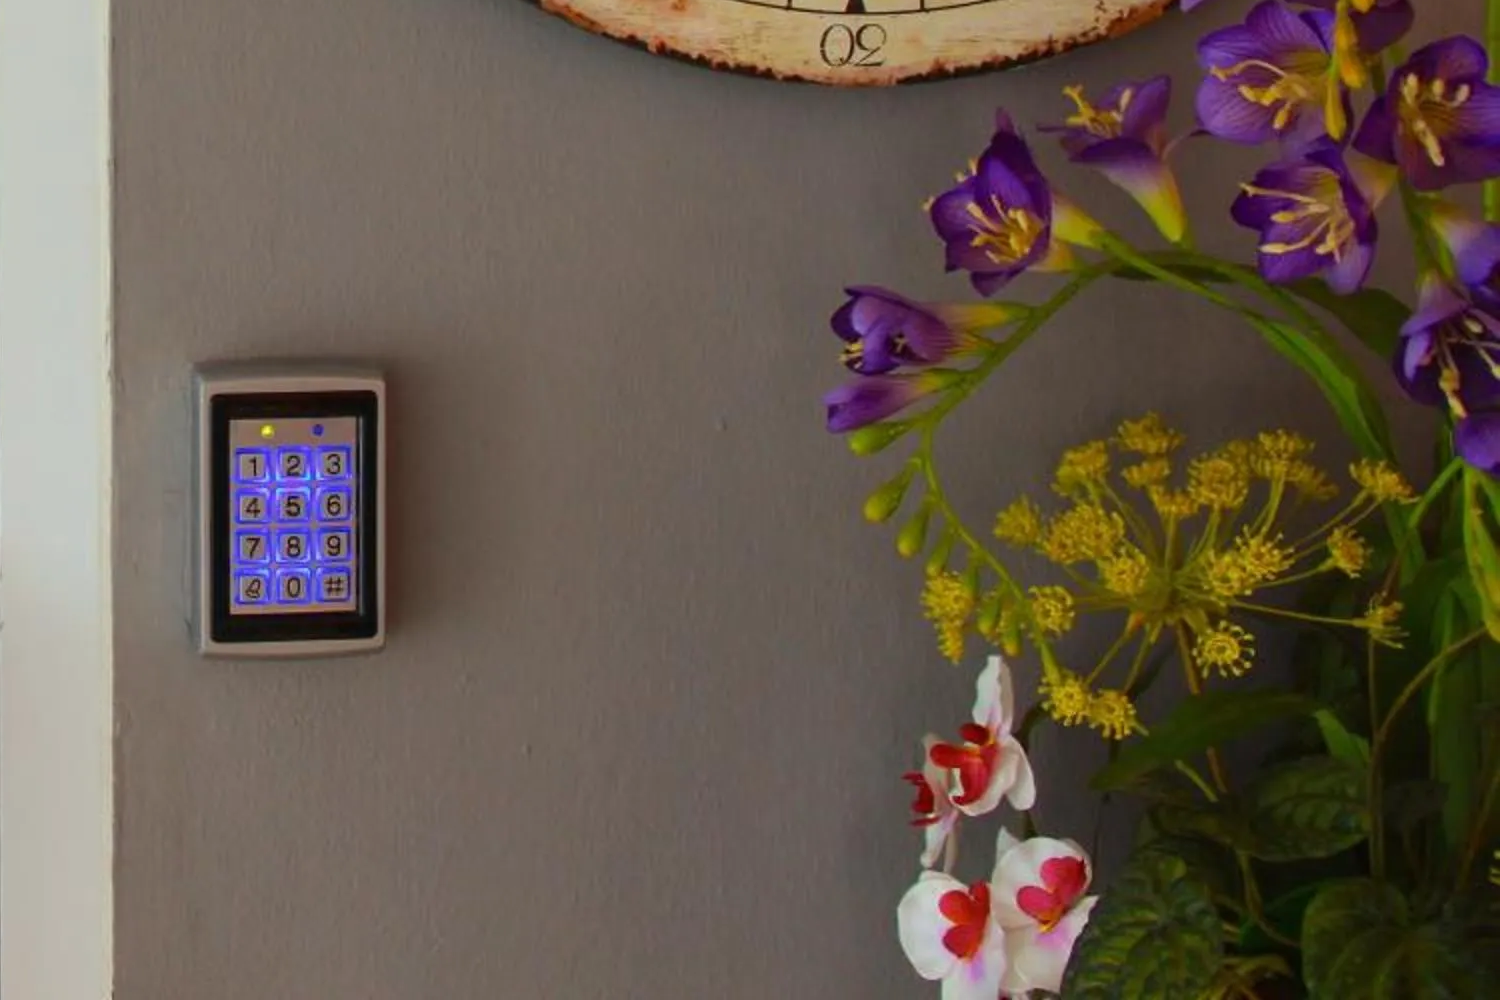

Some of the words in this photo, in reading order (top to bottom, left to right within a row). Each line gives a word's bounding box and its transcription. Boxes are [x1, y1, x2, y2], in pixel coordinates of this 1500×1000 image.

[286, 455, 301, 477] 2
[325, 453, 341, 475] 3
[245, 497, 261, 518] 4
[285, 495, 301, 517] 5
[325, 494, 341, 516] 6
[246, 537, 261, 558] 7
[286, 535, 301, 558] 8
[326, 535, 341, 557] 9
[286, 577, 301, 598] 0
